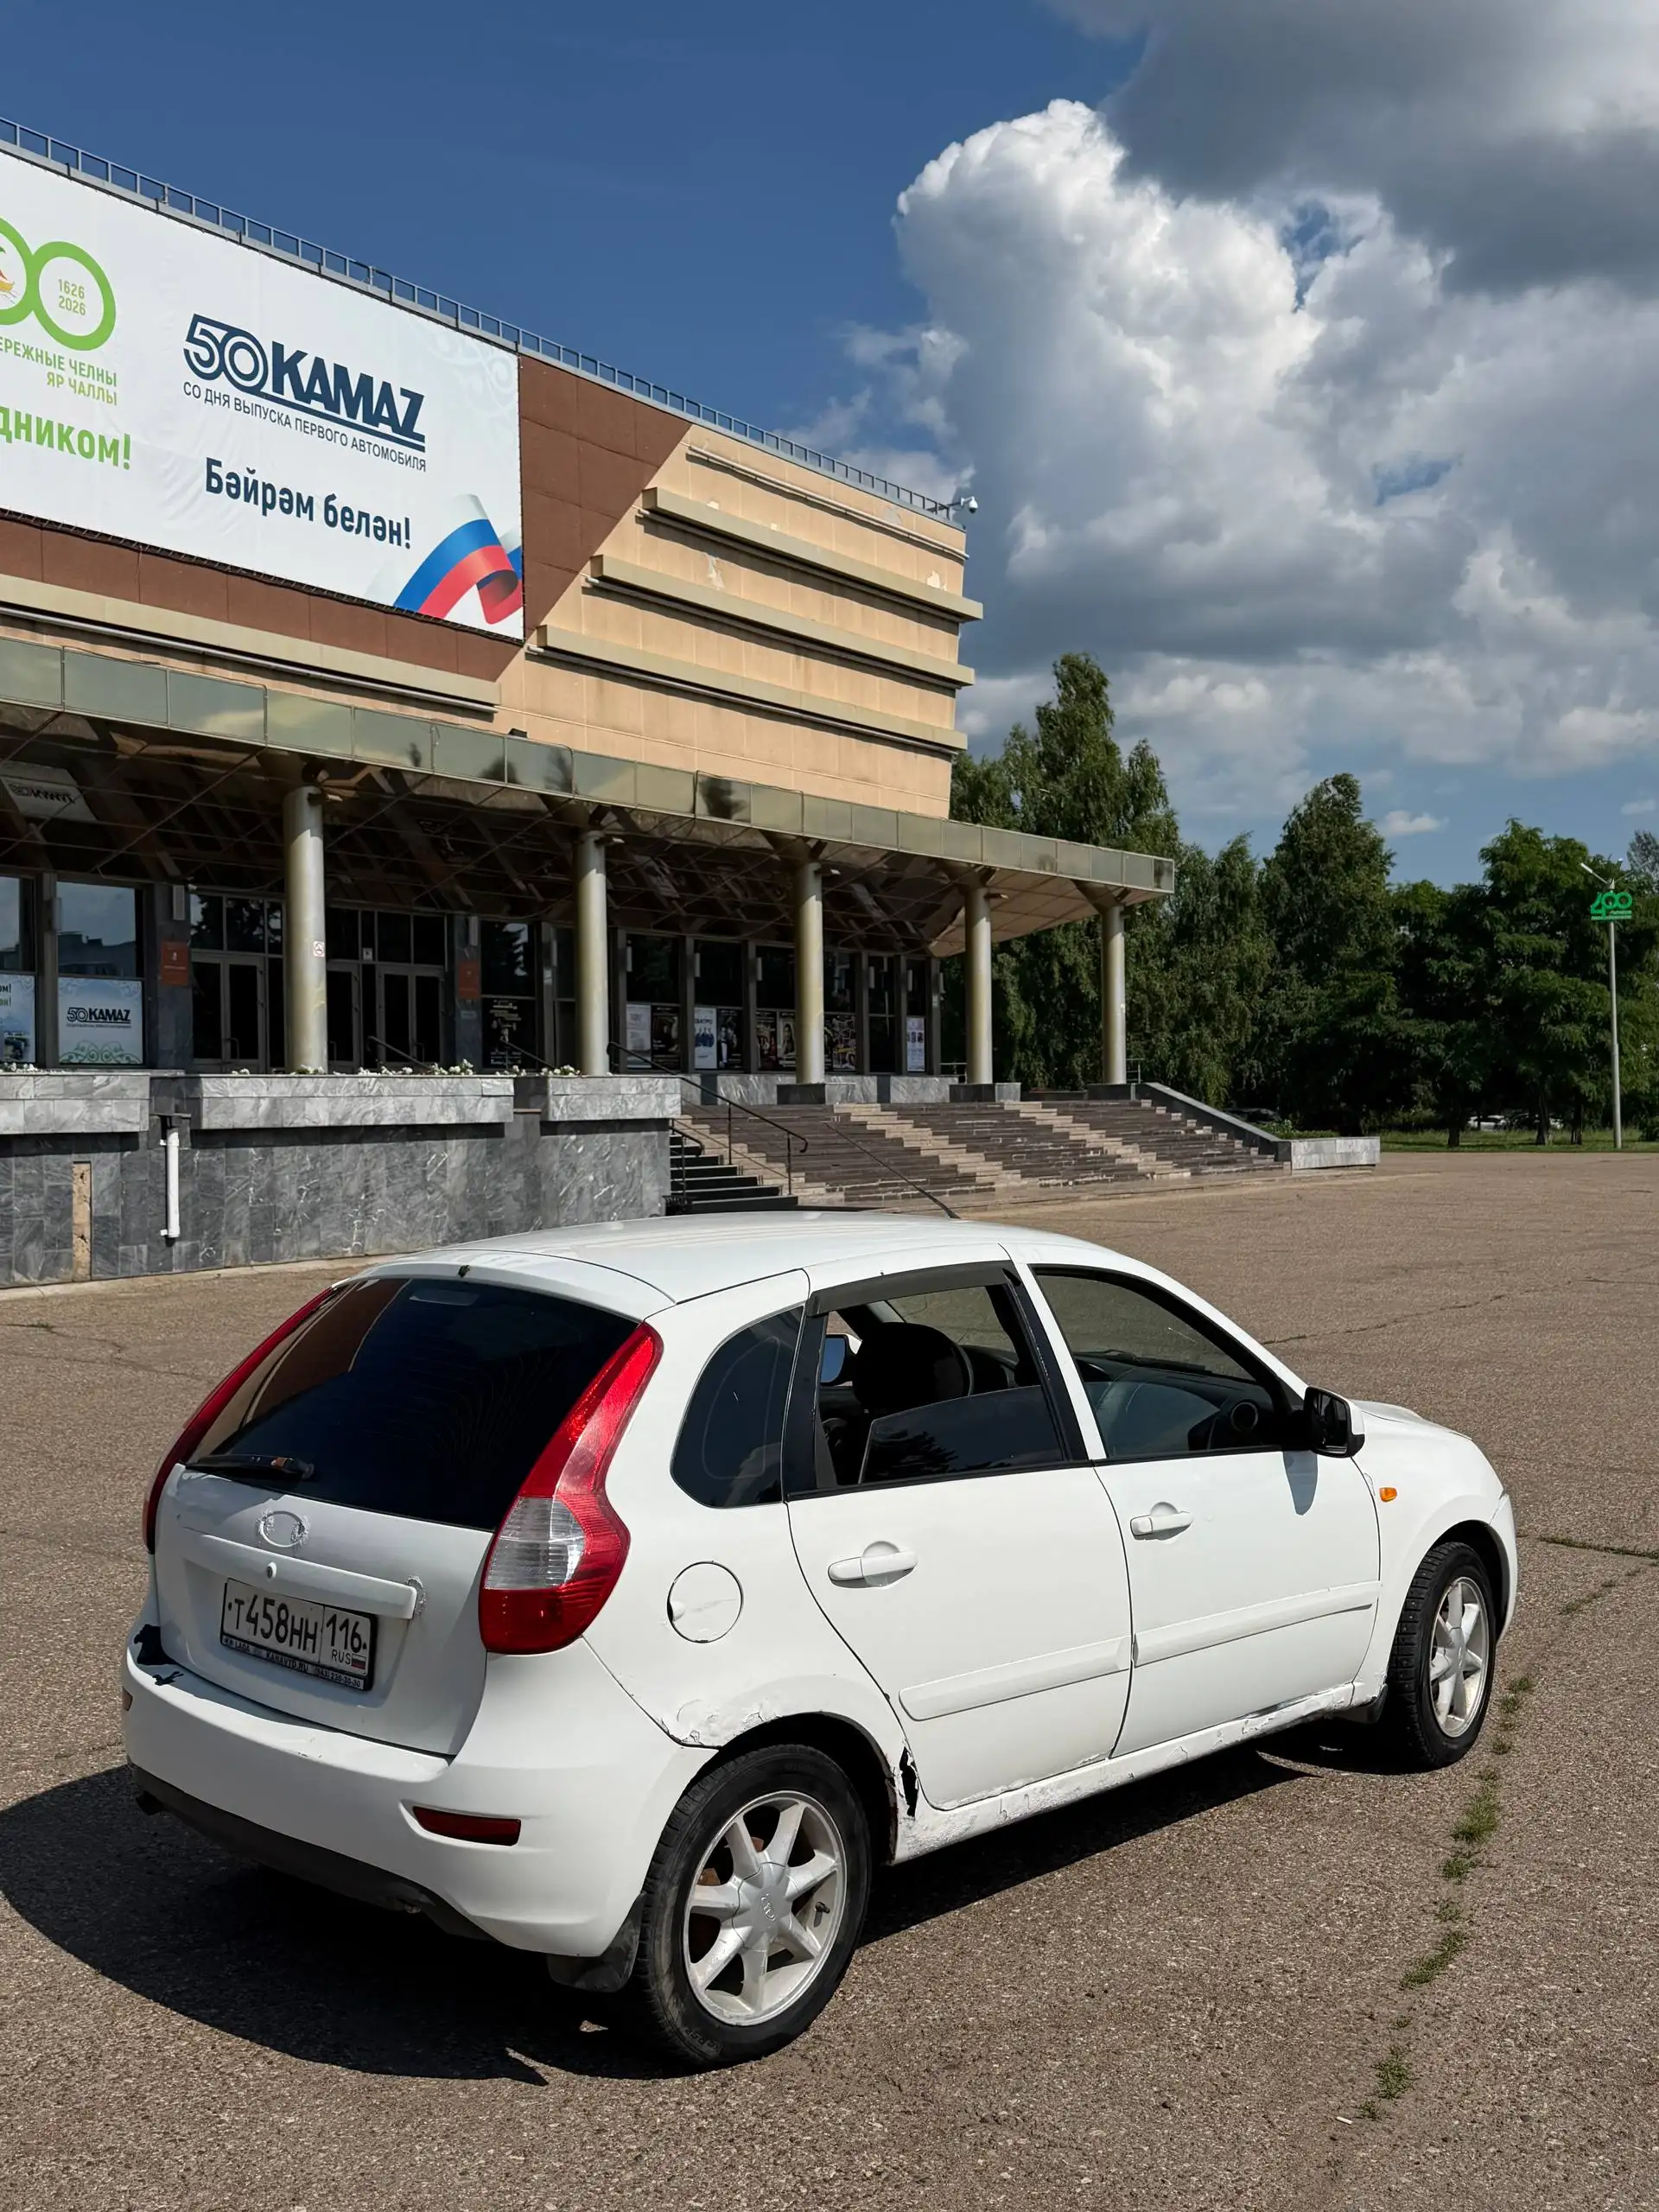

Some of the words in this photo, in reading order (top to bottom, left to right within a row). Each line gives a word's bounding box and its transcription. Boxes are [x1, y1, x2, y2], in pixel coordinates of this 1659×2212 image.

[58, 278, 85, 300] 1626
[58, 295, 86, 316] 2026
[68, 358, 117, 387] ЧЕЛНЫ
[47, 371, 65, 389] ЯР
[68, 377, 117, 406] ЧАЛЛЫ
[271, 340, 426, 448] KAMAZ
[183, 381, 201, 399] СО
[204, 387, 231, 410] ДНЯ
[233, 397, 292, 429] ВЫПУСКА
[295, 417, 348, 447] ПЕРВОГО
[351, 436, 427, 473] АВТОМОБИЛЯ
[206, 456, 315, 523] Бәйрәм
[323, 493, 412, 550] белән!
[1590, 891, 1633, 921] 400
[89, 1007, 131, 1024] KAMAZ
[326, 1613, 363, 1654] 116
[331, 1649, 352, 1666] RUS
